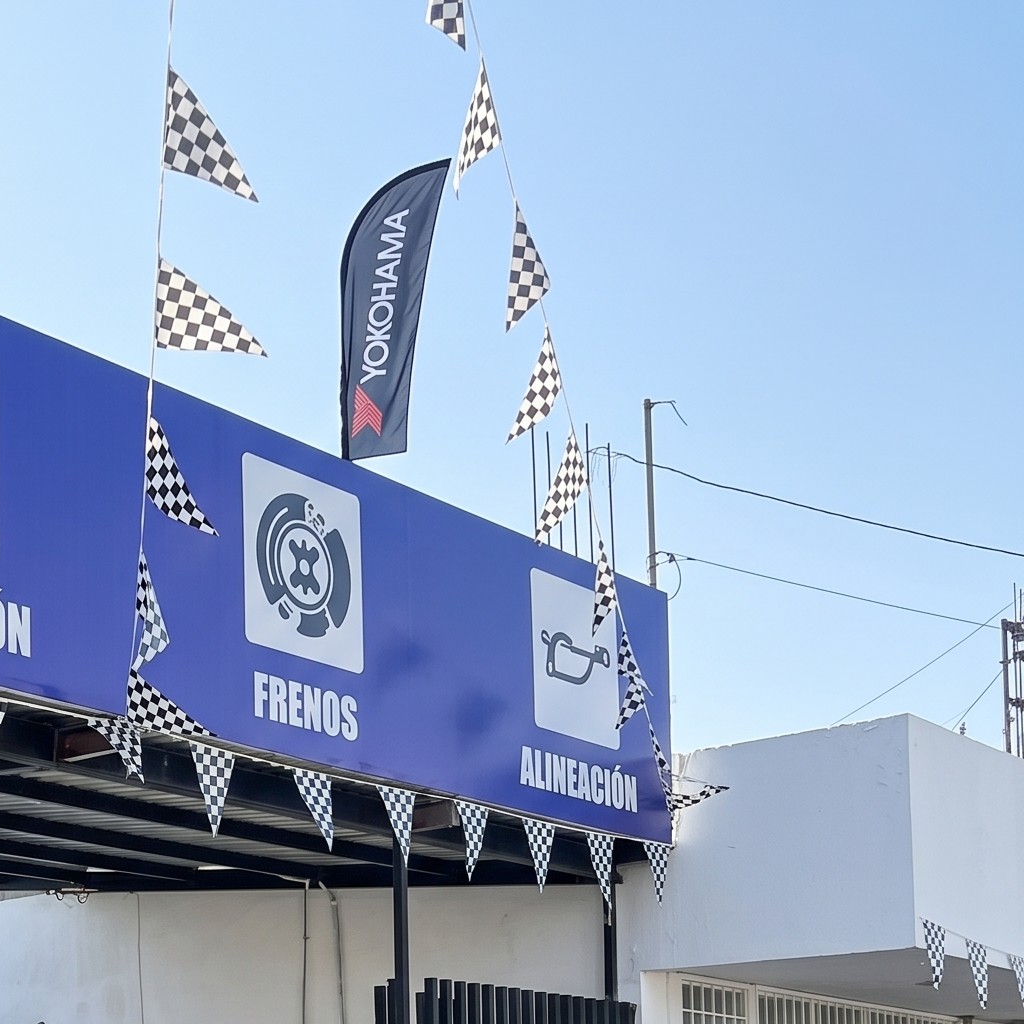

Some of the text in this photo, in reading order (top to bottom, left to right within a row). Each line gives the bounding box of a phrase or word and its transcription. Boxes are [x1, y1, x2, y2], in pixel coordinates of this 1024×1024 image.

[360, 208, 410, 385] YOKOHAMA
[252, 670, 359, 742] FRENOS
[519, 745, 639, 814] ALINEACIÓN
